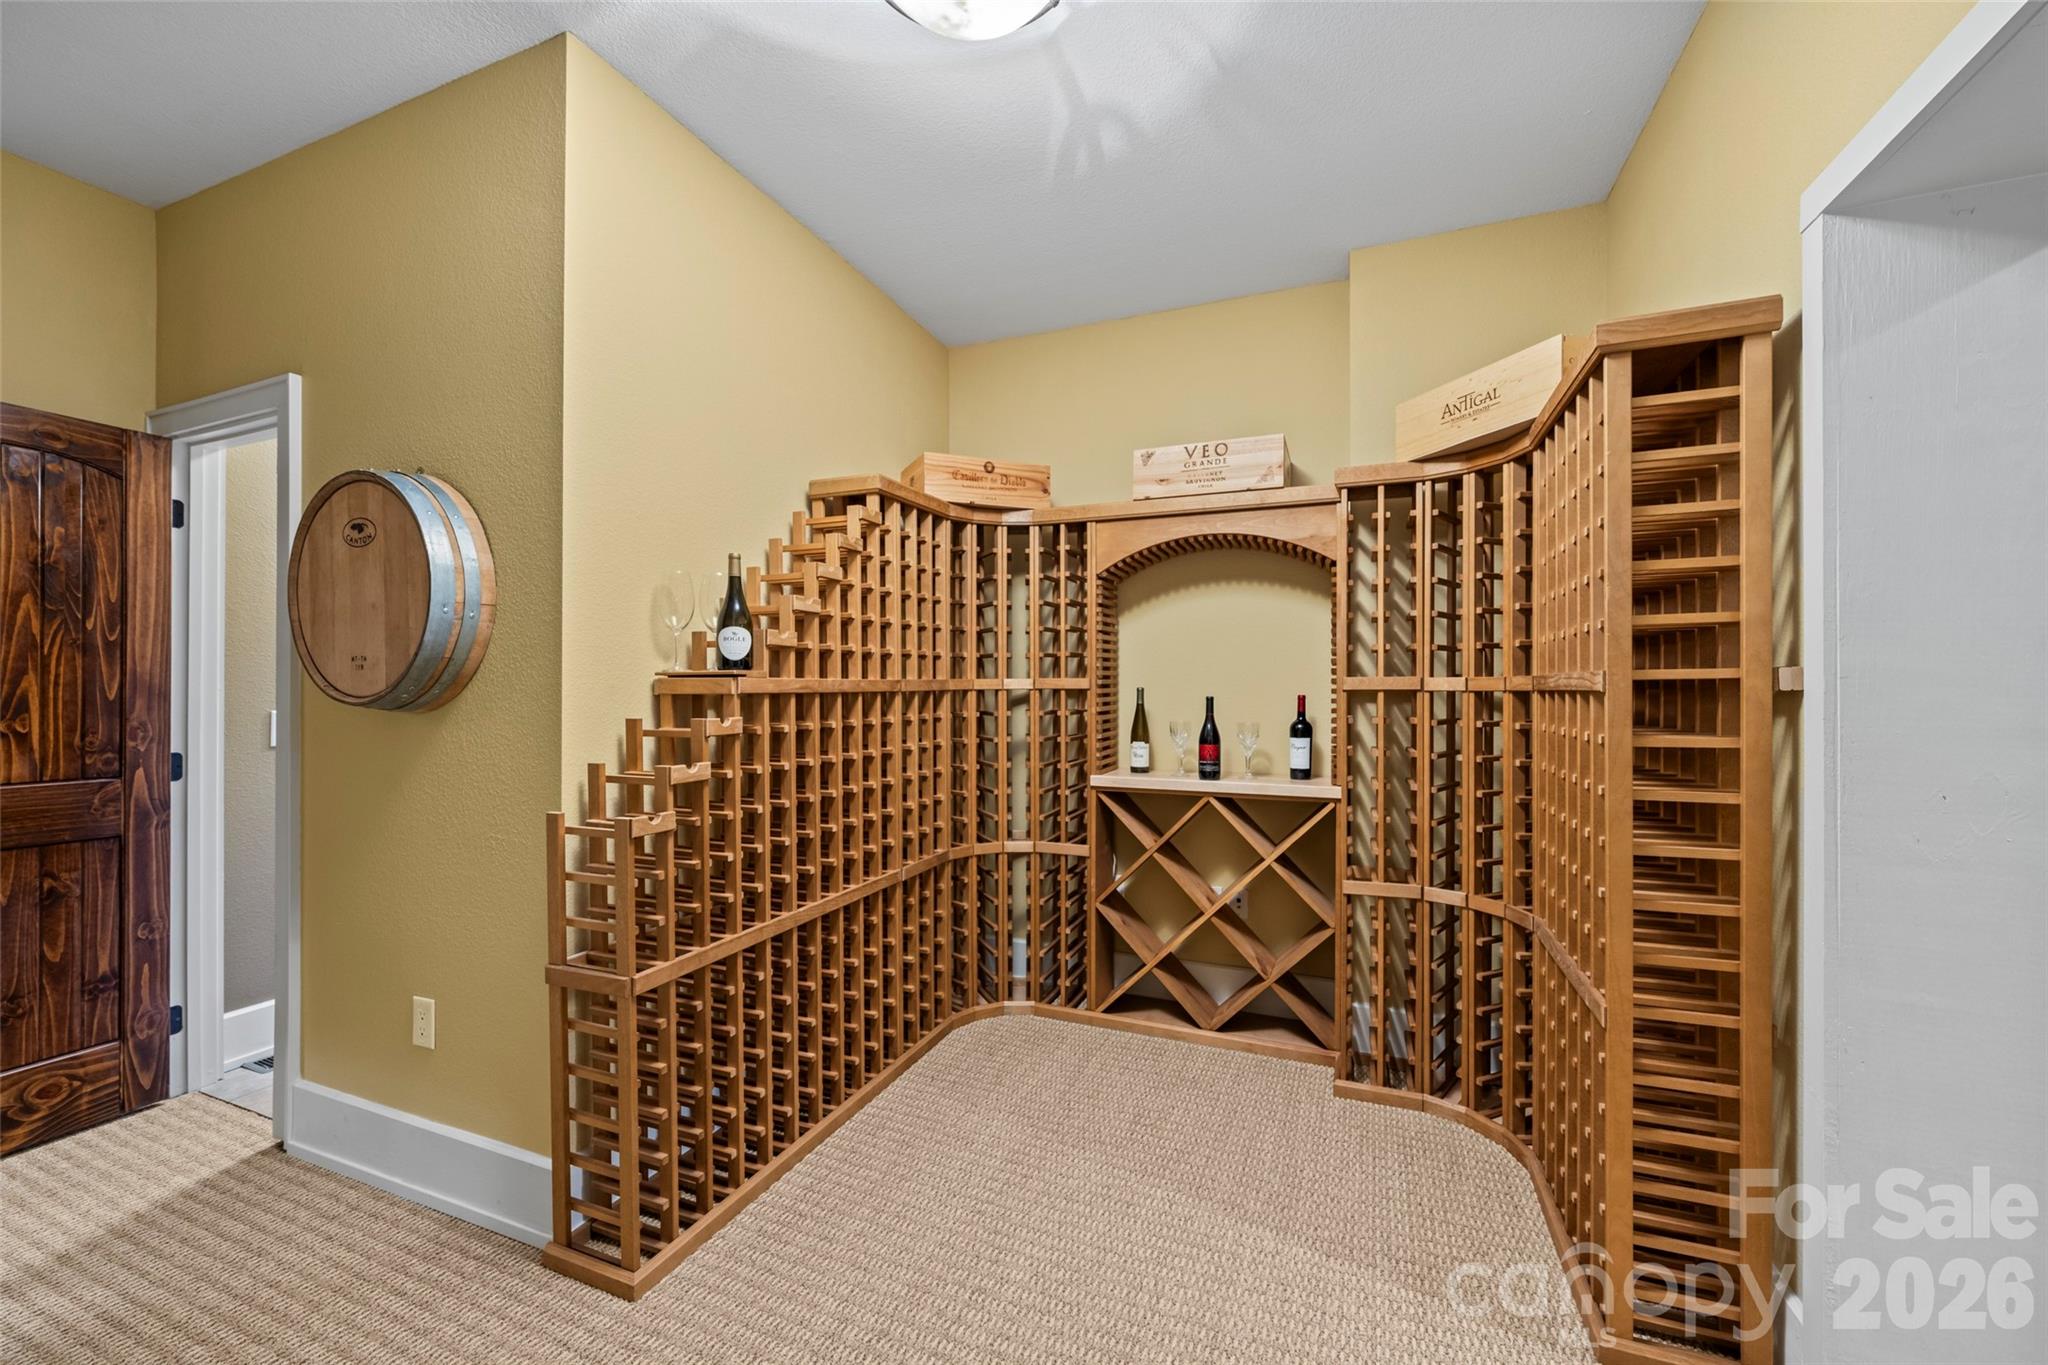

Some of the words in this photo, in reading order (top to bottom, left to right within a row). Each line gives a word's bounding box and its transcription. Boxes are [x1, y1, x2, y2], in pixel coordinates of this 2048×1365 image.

[1183, 442, 1228, 460] VEO
[1183, 457, 1227, 469] GRANDE
[345, 532, 372, 545] CANTON
